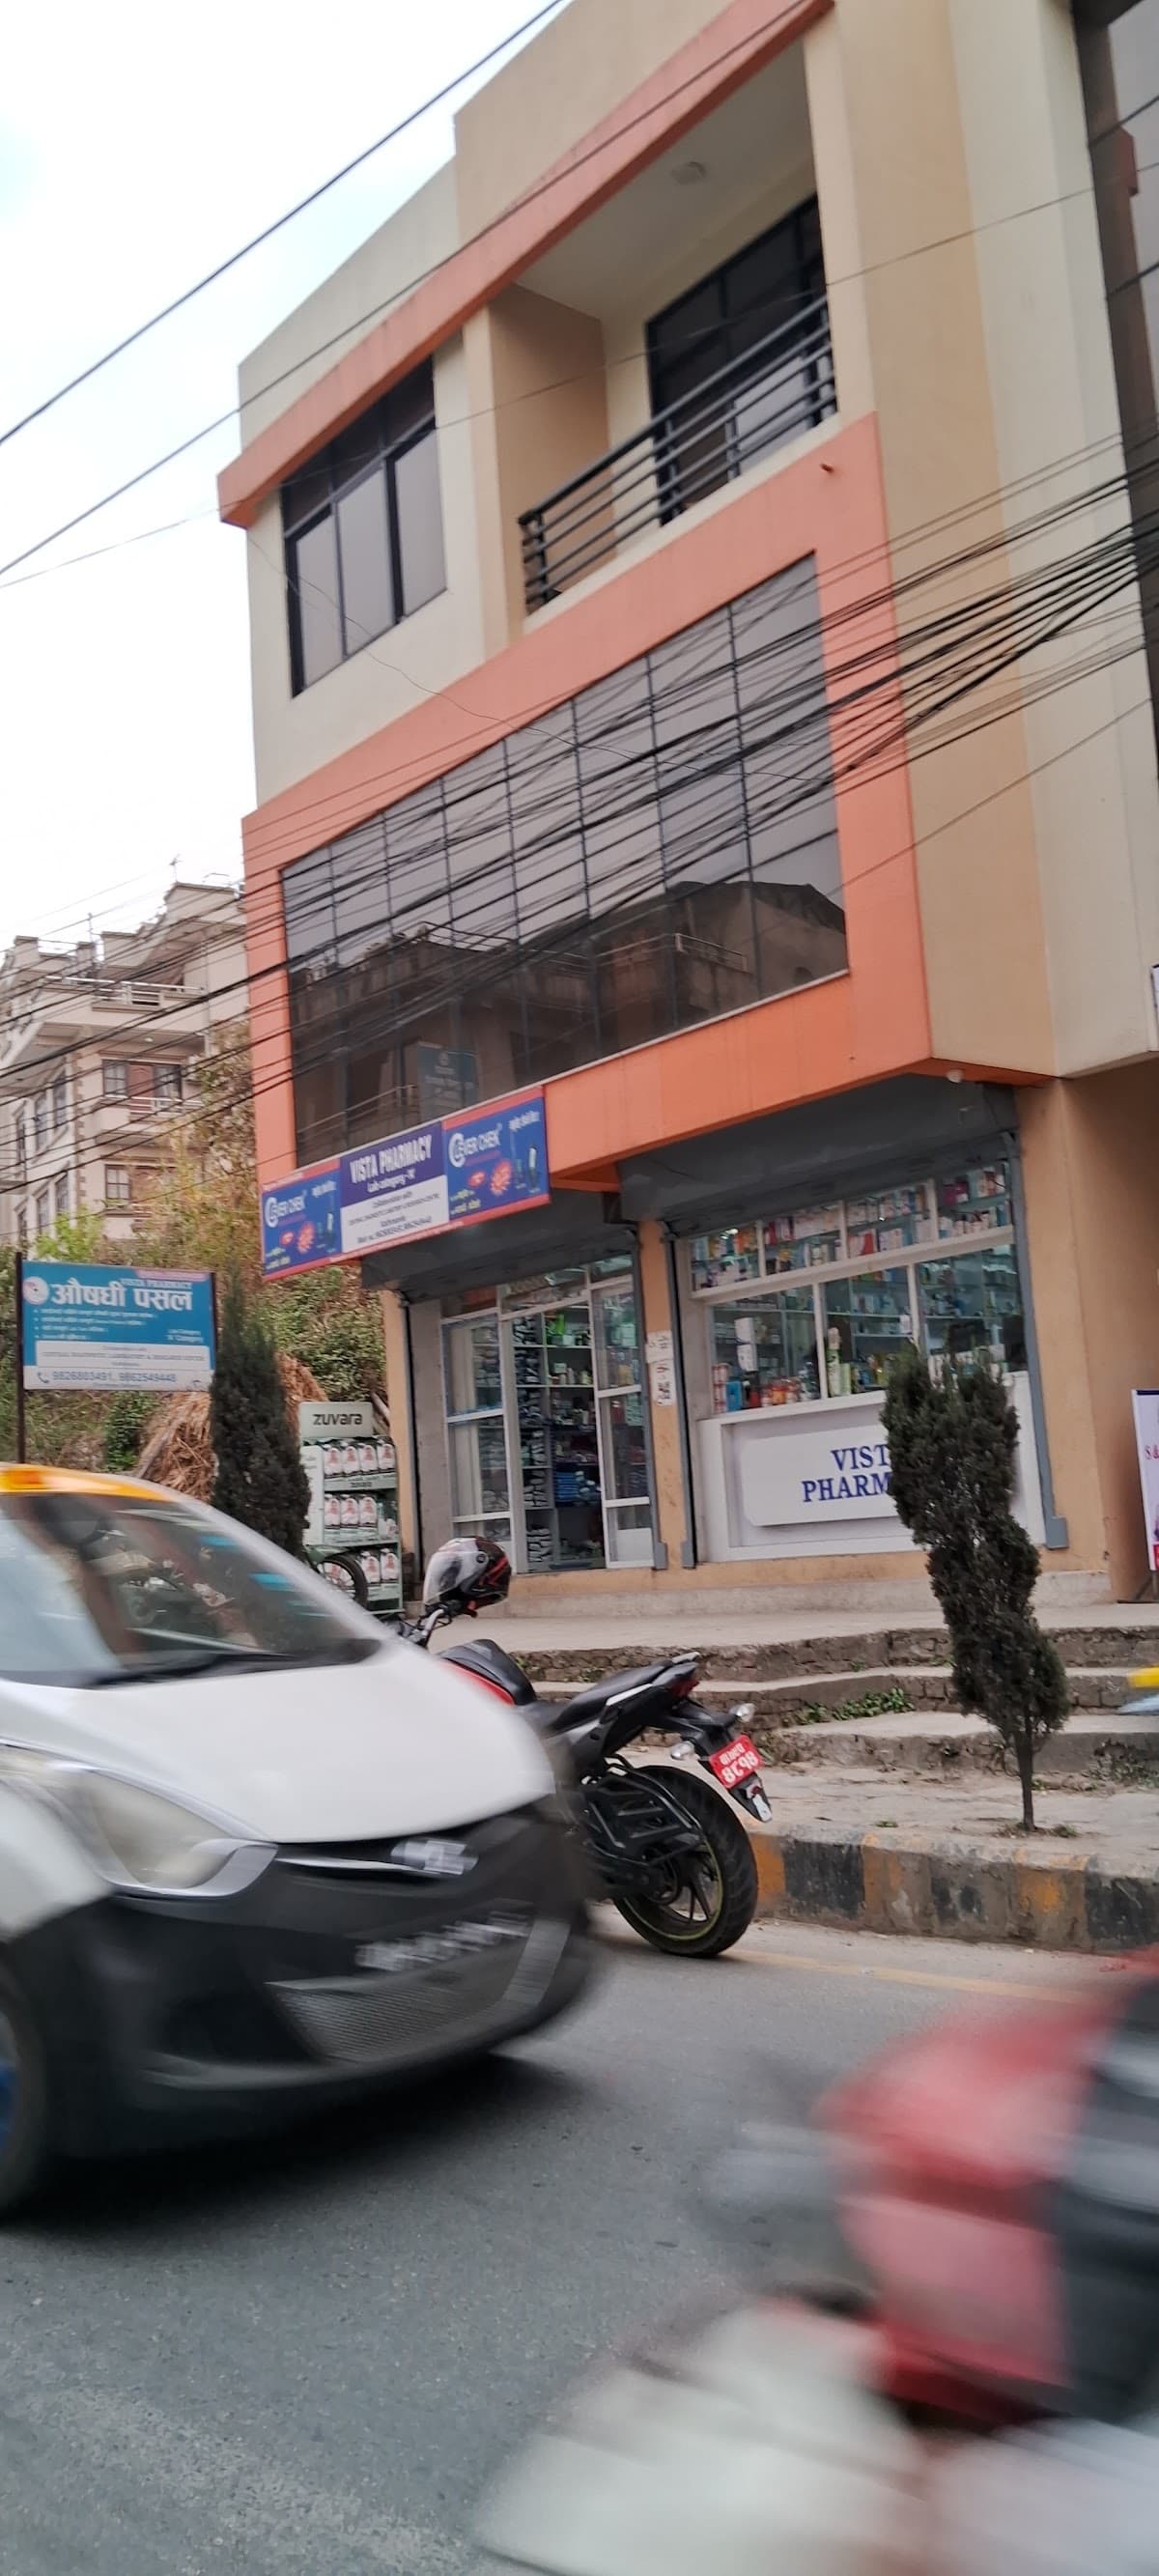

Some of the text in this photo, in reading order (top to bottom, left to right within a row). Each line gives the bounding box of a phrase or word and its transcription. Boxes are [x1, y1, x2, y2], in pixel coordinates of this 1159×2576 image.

[350, 1135, 432, 1183] VISTA PHARMACY
[133, 1288, 192, 1312] पसल
[312, 1412, 363, 1427] zuvara
[831, 1443, 890, 1472] VIST
[802, 1471, 892, 1503] PHARM
